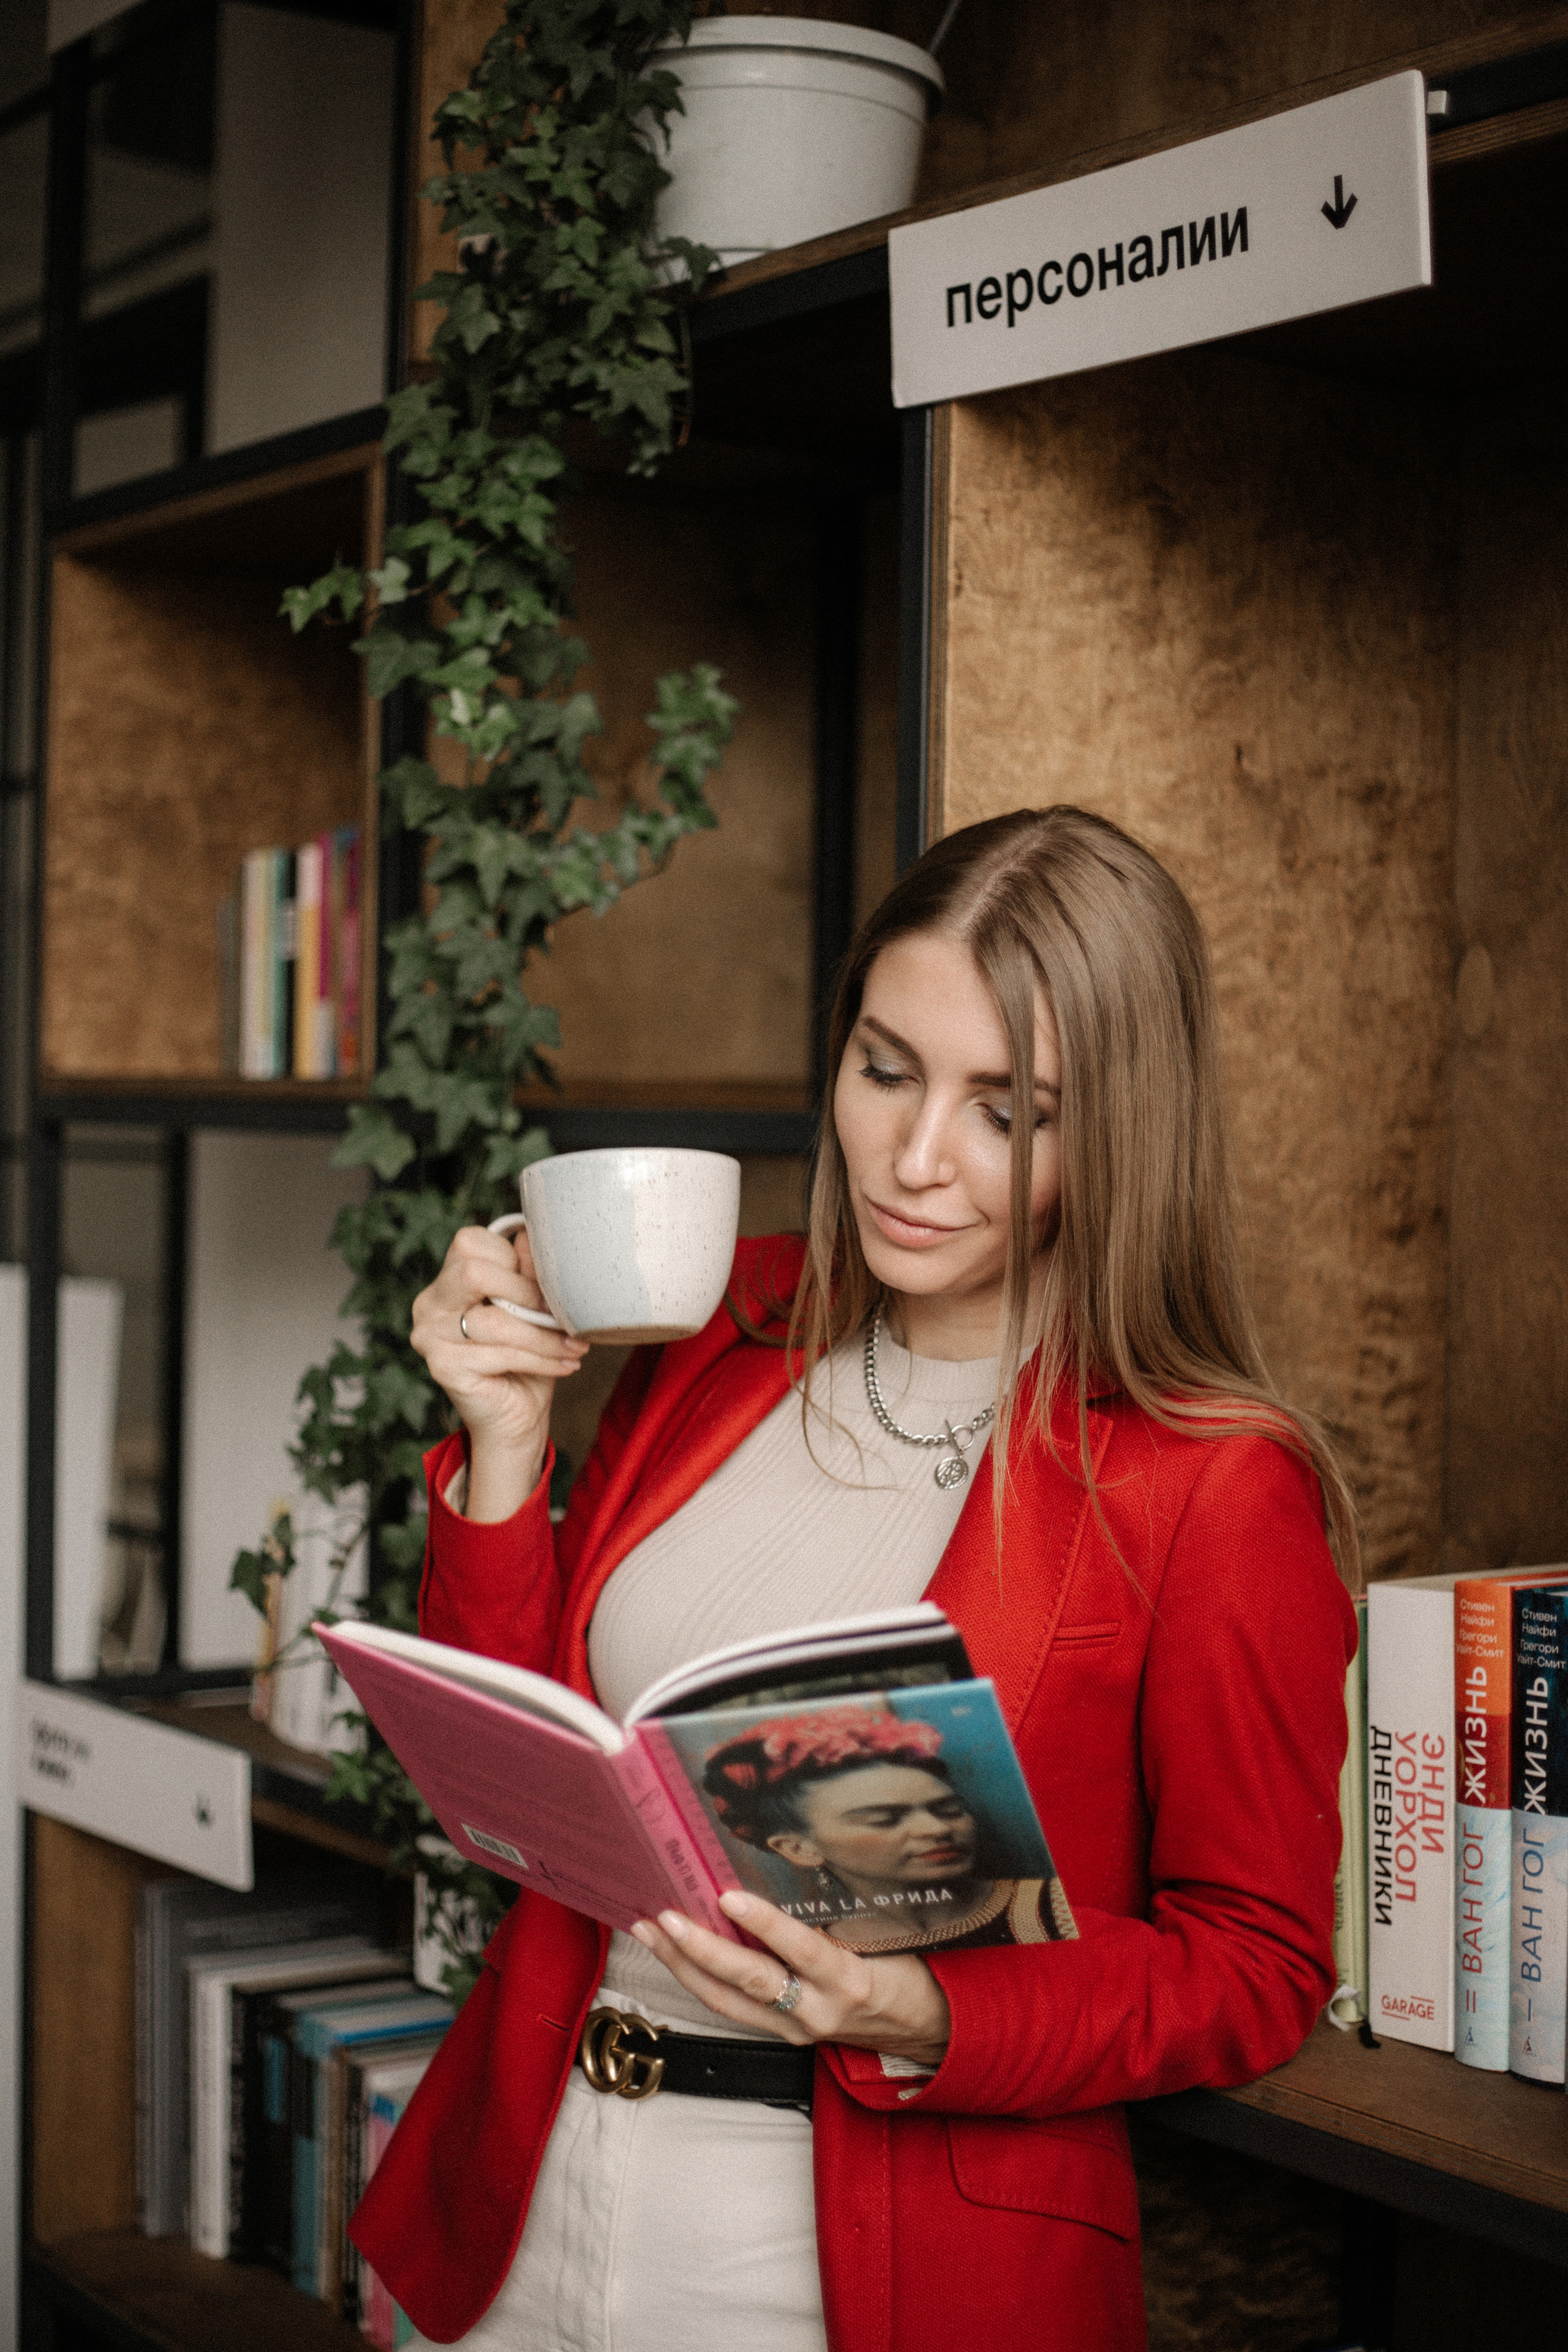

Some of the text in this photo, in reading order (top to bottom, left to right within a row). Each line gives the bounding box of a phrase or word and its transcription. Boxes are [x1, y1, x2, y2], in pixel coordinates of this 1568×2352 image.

[945, 206, 1250, 328] персоналии
[1520, 1639, 1559, 1655] Грегори
[1522, 1608, 1558, 1623] Стивен
[1522, 1623, 1556, 1638] Найфи
[1370, 1725, 1392, 1926] ДНЕВНИКИ
[1395, 1731, 1417, 1902] УОРХОЛ
[1417, 1732, 1445, 1853] ЭНДИ
[1462, 1666, 1488, 1974] ВАН ГОГ ЖИЗНЬ
[1521, 1676, 1549, 1983] ВАН ГОГ ЖИЗНЬ
[780, 1888, 953, 1915] VIVA LA ФРИДА
[1381, 1994, 1434, 2020] GARAGE
